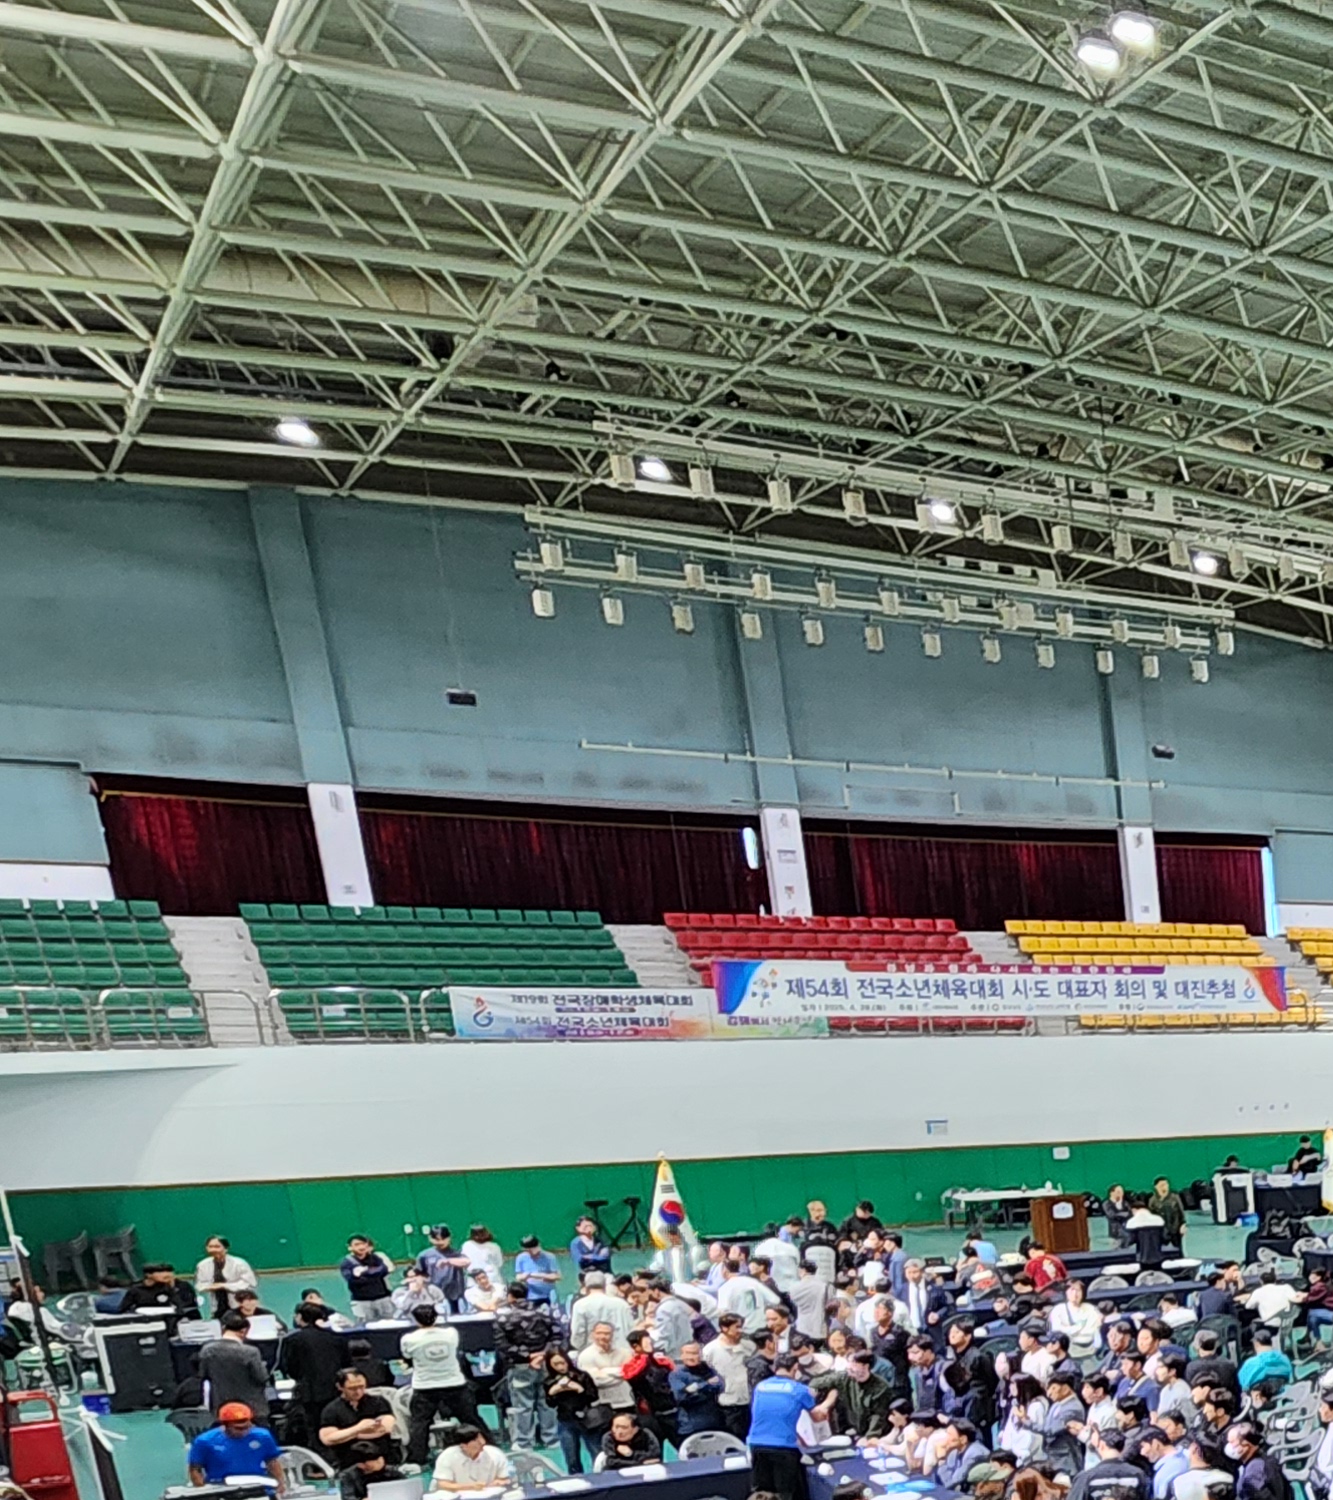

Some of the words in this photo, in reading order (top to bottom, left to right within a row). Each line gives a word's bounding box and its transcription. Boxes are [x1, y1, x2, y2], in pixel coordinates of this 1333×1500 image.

[785, 977, 849, 999] 제54회
[857, 977, 1004, 1000] 전국소년체육대회
[1012, 978, 1051, 999] 시·도
[1057, 978, 1107, 999] 대표자
[1115, 978, 1147, 999] 회의
[1153, 979, 1168, 999] 및
[1174, 979, 1236, 999] 대진추첨
[556, 1016, 669, 1028] 전국소년체육대회
